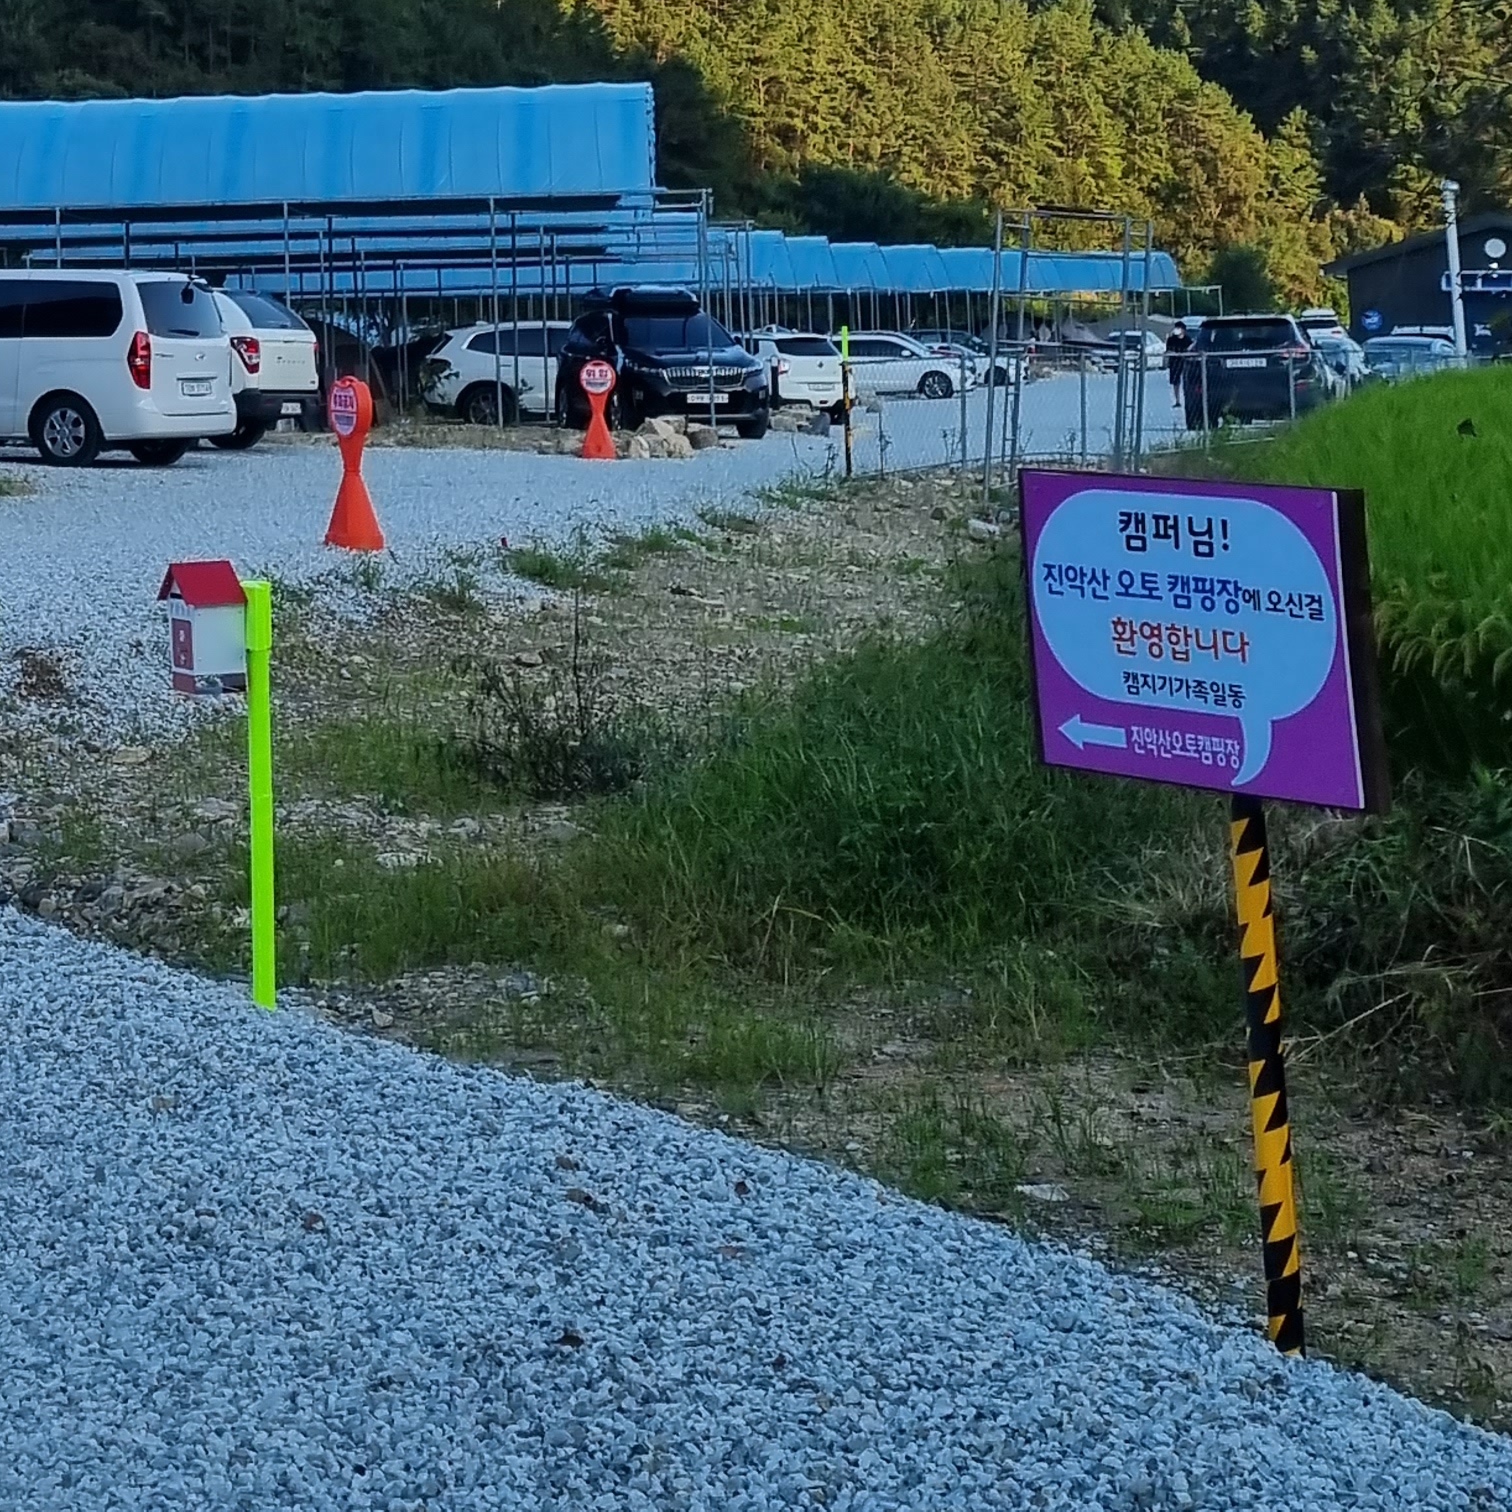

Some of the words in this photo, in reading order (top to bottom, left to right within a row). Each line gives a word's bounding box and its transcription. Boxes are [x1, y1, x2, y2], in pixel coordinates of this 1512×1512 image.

[1118, 510, 1231, 558] 캠퍼님!
[1041, 562, 1110, 601] 진악산
[1115, 569, 1163, 601] 오토
[1167, 574, 1261, 615] 캠핑장에
[1264, 589, 1326, 622] 오신걸
[1111, 616, 1250, 663] 환영합니다
[1122, 670, 1246, 709] 캠지기가족일동
[1130, 725, 1240, 769] 진악산오토캠핑장
